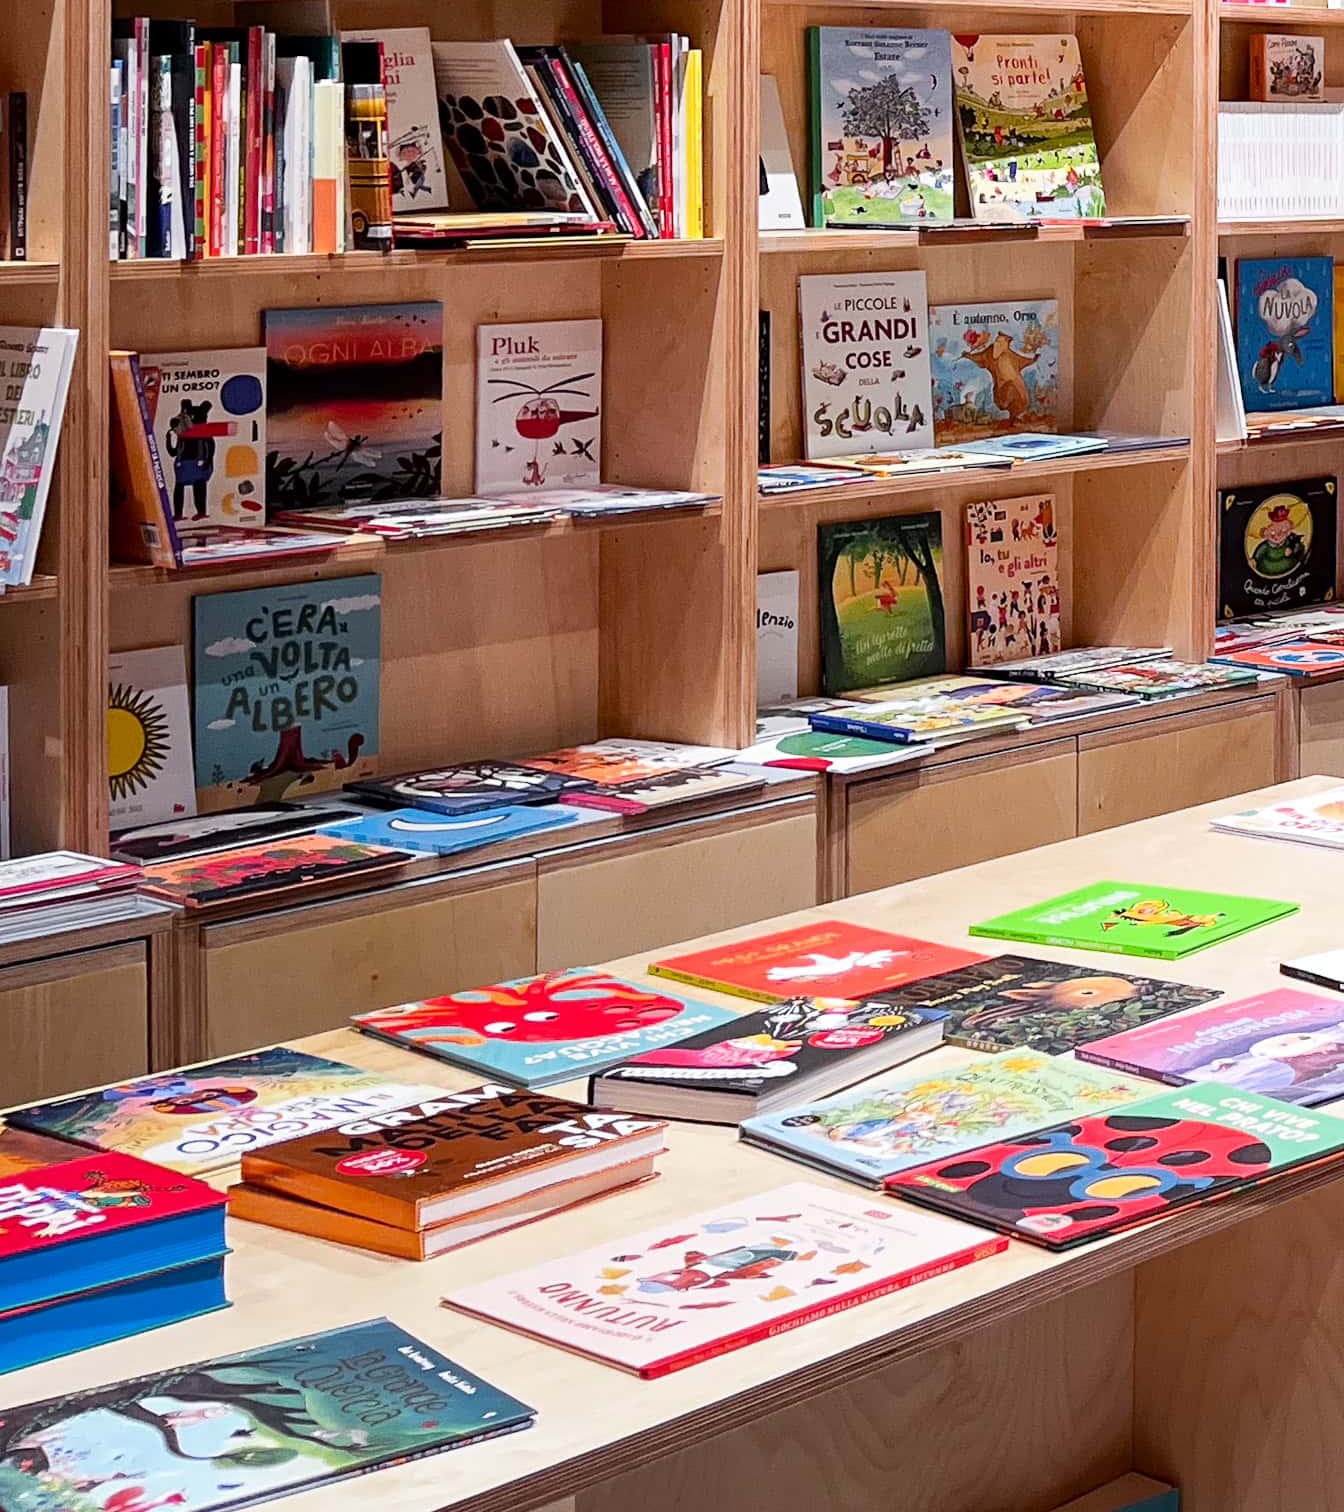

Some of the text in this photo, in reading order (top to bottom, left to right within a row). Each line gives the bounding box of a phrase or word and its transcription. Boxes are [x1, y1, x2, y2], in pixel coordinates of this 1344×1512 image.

[874, 52, 900, 61] Estate
[997, 54, 1039, 69] Pronti
[991, 72, 1003, 84] si
[845, 297, 897, 312] PICCOLE
[1281, 289, 1291, 299] LA
[1014, 310, 1037, 322] Orso
[1263, 295, 1313, 320] NUVOLA
[823, 317, 917, 343] GRANDI
[284, 343, 359, 367] OGNI
[491, 335, 540, 356] Pluk
[845, 351, 892, 369] COSE
[162, 369, 220, 381] TI SEMBRO
[162, 381, 220, 393] UN ORSO?
[859, 378, 880, 386] DELLA
[814, 392, 925, 439] SCUOLA
[997, 548, 1010, 562] tu
[1007, 552, 1048, 578] gli altri
[250, 640, 350, 679] VOLTA
[222, 665, 255, 686] una
[259, 683, 279, 697] un
[225, 675, 358, 731] ALBERO
[338, 1082, 516, 1136] GRAM
[1170, 1098, 1321, 1142] NEL PRATO?
[1219, 1097, 1321, 1128] CHI VIVE
[177, 1097, 378, 1155] MAGICO
[558, 1120, 661, 1148] SIA
[538, 1281, 689, 1332] AUTUNNO
[768, 1298, 859, 1337] GIOCHIAMO NELLA
[294, 1365, 402, 1427] Quercia
[354, 1362, 448, 1414] grande
